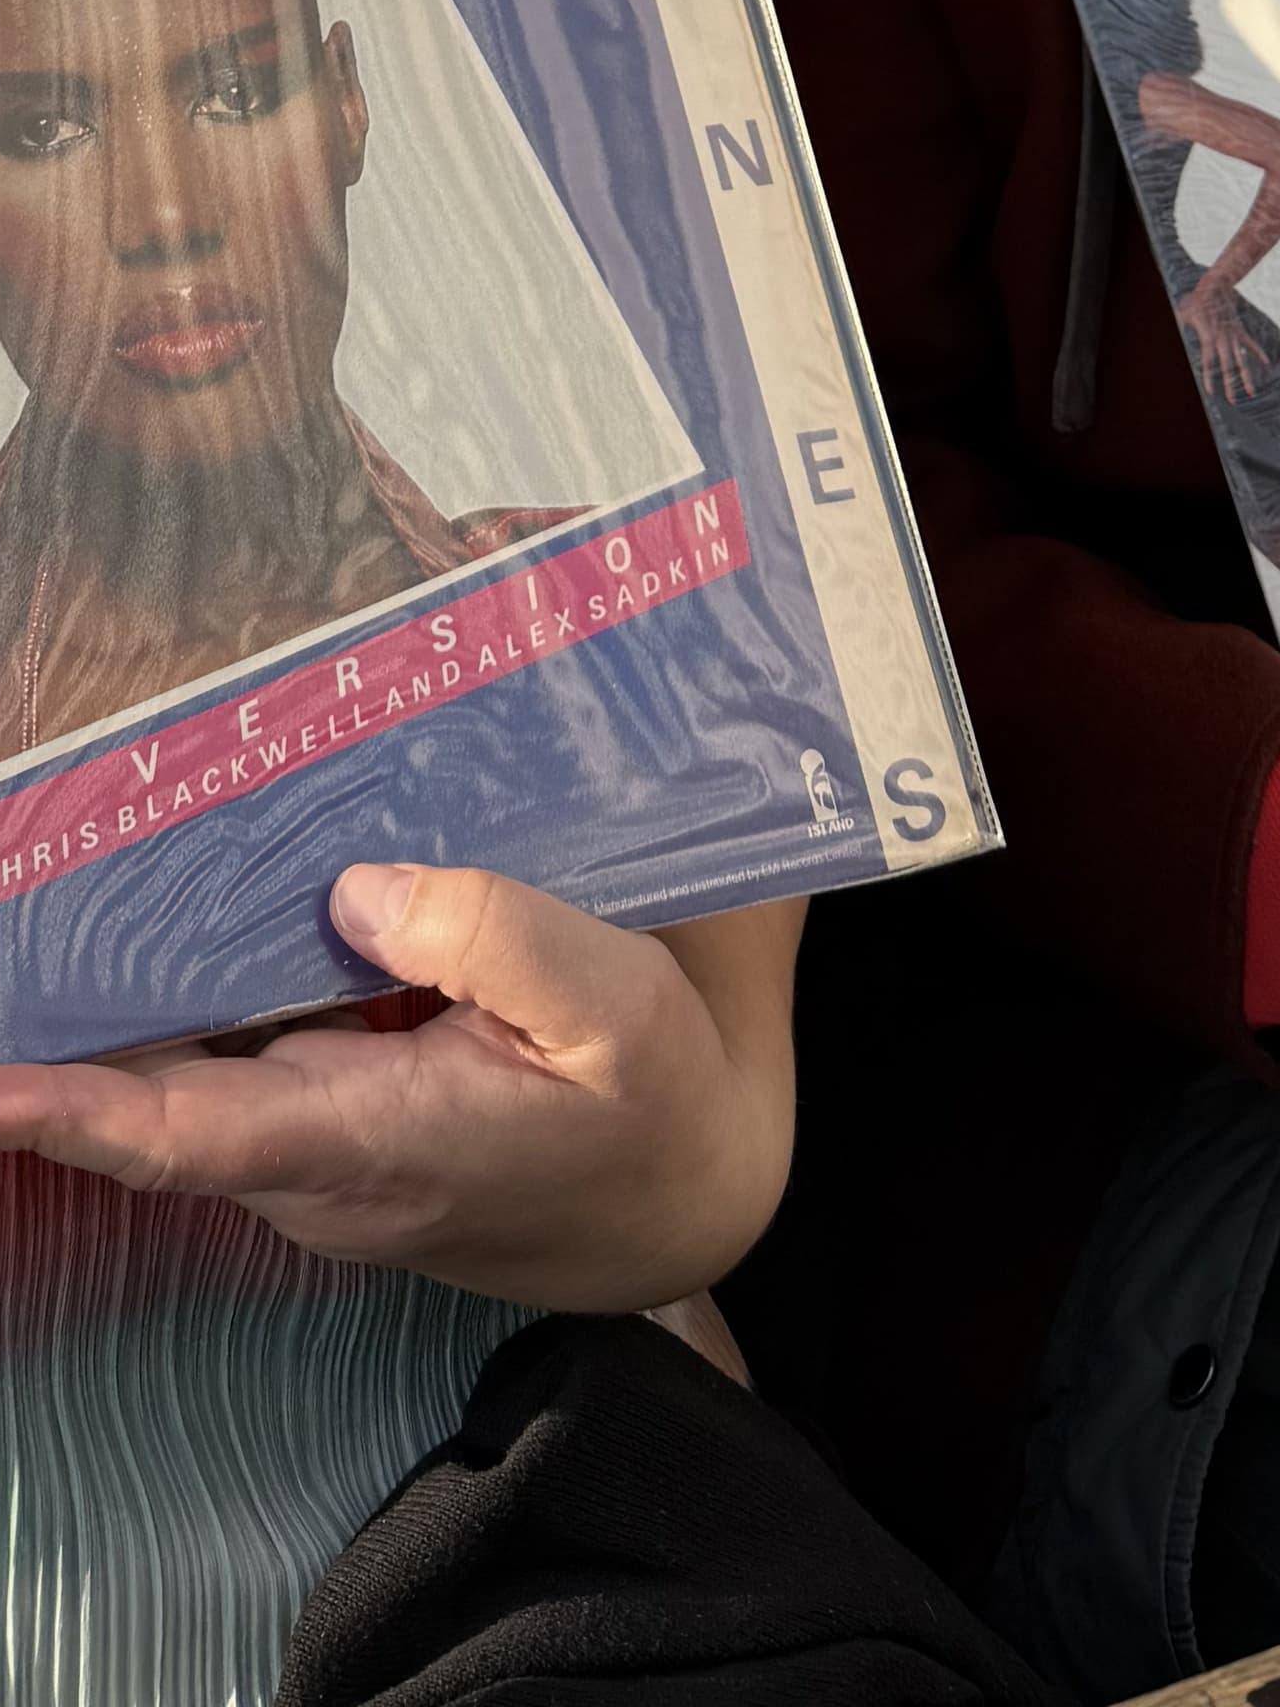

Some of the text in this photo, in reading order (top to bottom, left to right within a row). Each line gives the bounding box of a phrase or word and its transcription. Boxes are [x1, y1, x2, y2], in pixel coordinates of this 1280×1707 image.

[117, 704, 369, 835] BLACKWELL
[385, 660, 461, 717] AND
[478, 608, 576, 673] ALEX
[589, 537, 730, 621] SADKIN
[130, 494, 721, 785] VERSION
[807, 817, 855, 838] ISLAND
